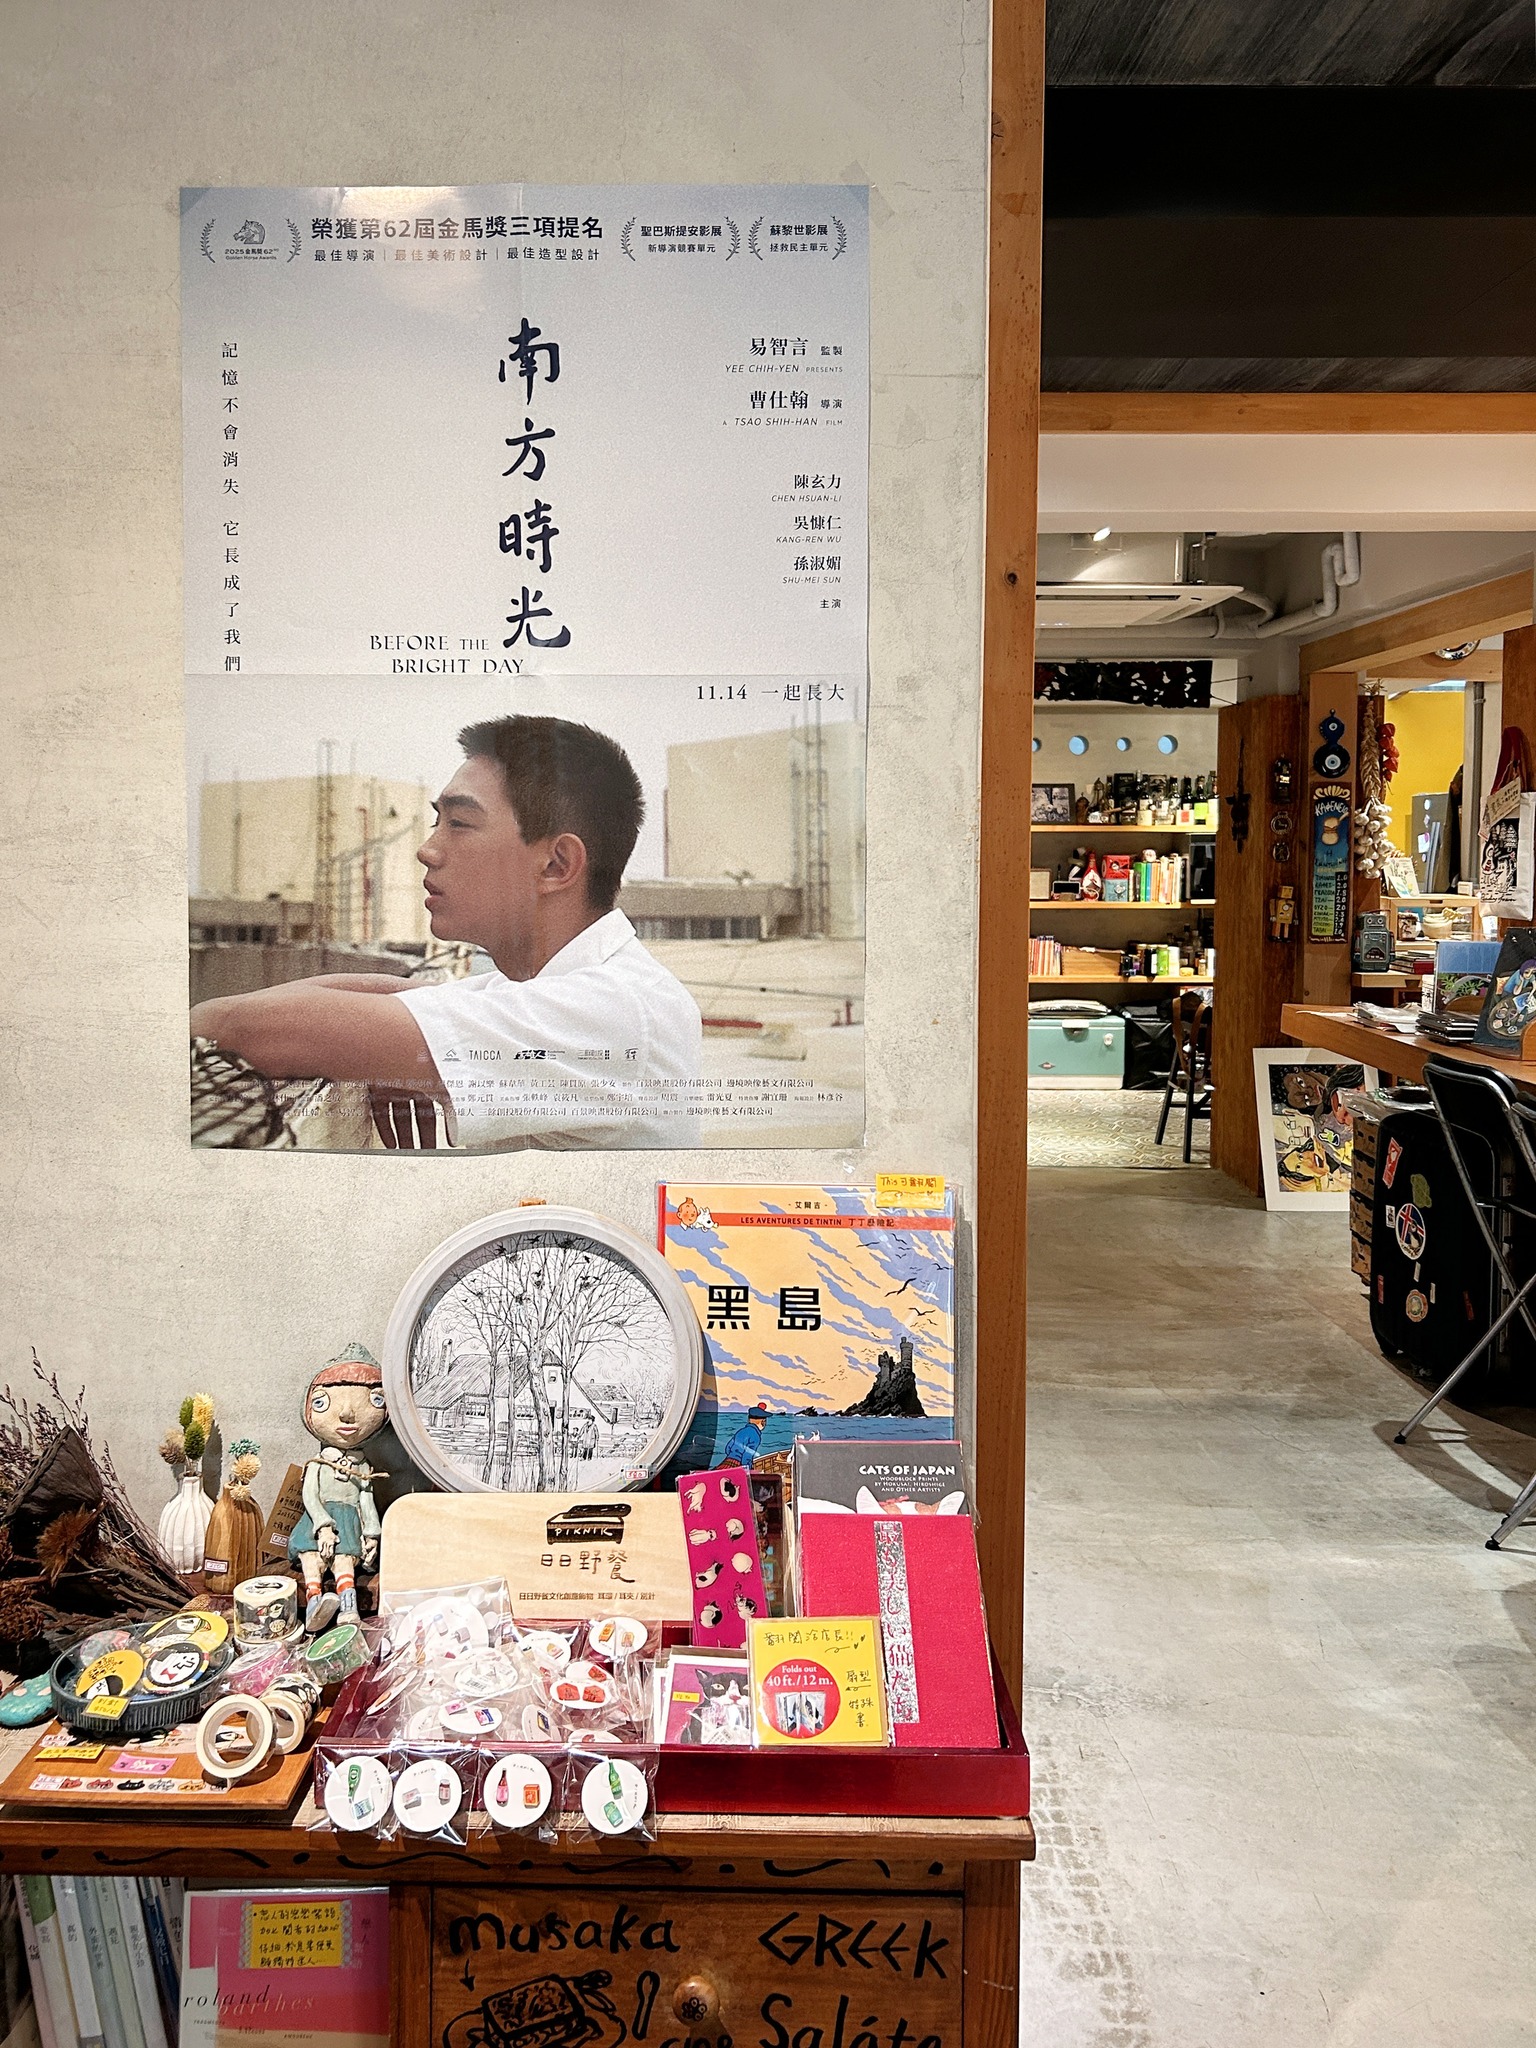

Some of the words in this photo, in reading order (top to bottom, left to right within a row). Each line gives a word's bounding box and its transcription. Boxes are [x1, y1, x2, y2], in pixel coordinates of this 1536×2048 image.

[311, 215, 603, 239] 榮獲第62屆金馬獎三項提名
[640, 225, 722, 237] 聖巴斯提安影展
[769, 224, 829, 236] 蘇黎世影展
[314, 248, 376, 262] 最佳導演
[394, 248, 488, 262] 最佳美術設計
[507, 246, 601, 261] 最佳造型設計
[749, 337, 809, 357] 易智言
[820, 345, 843, 356] 監製
[725, 364, 745, 373] YEE
[748, 364, 800, 373] CHIH-YEN
[749, 390, 809, 410] 曹仕翰
[820, 398, 843, 409] 導演
[221, 342, 240, 495] 記憶不會消失
[734, 417, 761, 426] TSAO
[765, 417, 818, 426] SHIH-HAN
[499, 317, 571, 649] 南方時光
[794, 473, 842, 490] 陳玄力
[771, 494, 796, 502] CHEN
[798, 494, 842, 502] HSUAN-LI
[793, 515, 842, 531] 吳慷仁
[776, 535, 824, 543] KANG-REN
[826, 535, 842, 543] WU
[793, 555, 842, 571] 孫淑媚
[782, 576, 821, 584] SHU-MEI
[822, 576, 842, 584] SUN
[223, 520, 241, 672] 它長成了我們
[819, 598, 842, 609] 主演
[370, 634, 450, 651] BEFORE
[459, 638, 490, 651] THE
[392, 658, 471, 674] BRIGHT
[483, 658, 524, 674] DAY
[696, 684, 748, 700] 11.14
[761, 683, 845, 701] 一起長大
[469, 1050, 501, 1061] TAICCA
[740, 1216, 754, 1224] LES
[756, 1217, 801, 1225] AVENTURES
[816, 1218, 842, 1226] TINTIN
[706, 1285, 823, 1331] 黑島
[858, 1465, 890, 1475] CATS
[892, 1465, 909, 1475] OF
[912, 1465, 956, 1476] JAPAN
[554, 1527, 614, 1538] PIKNIK
[781, 1665, 802, 1674] Folds
[803, 1665, 817, 1673] out
[183, 1984, 271, 2008] roland
[218, 1991, 314, 2017] barthes
